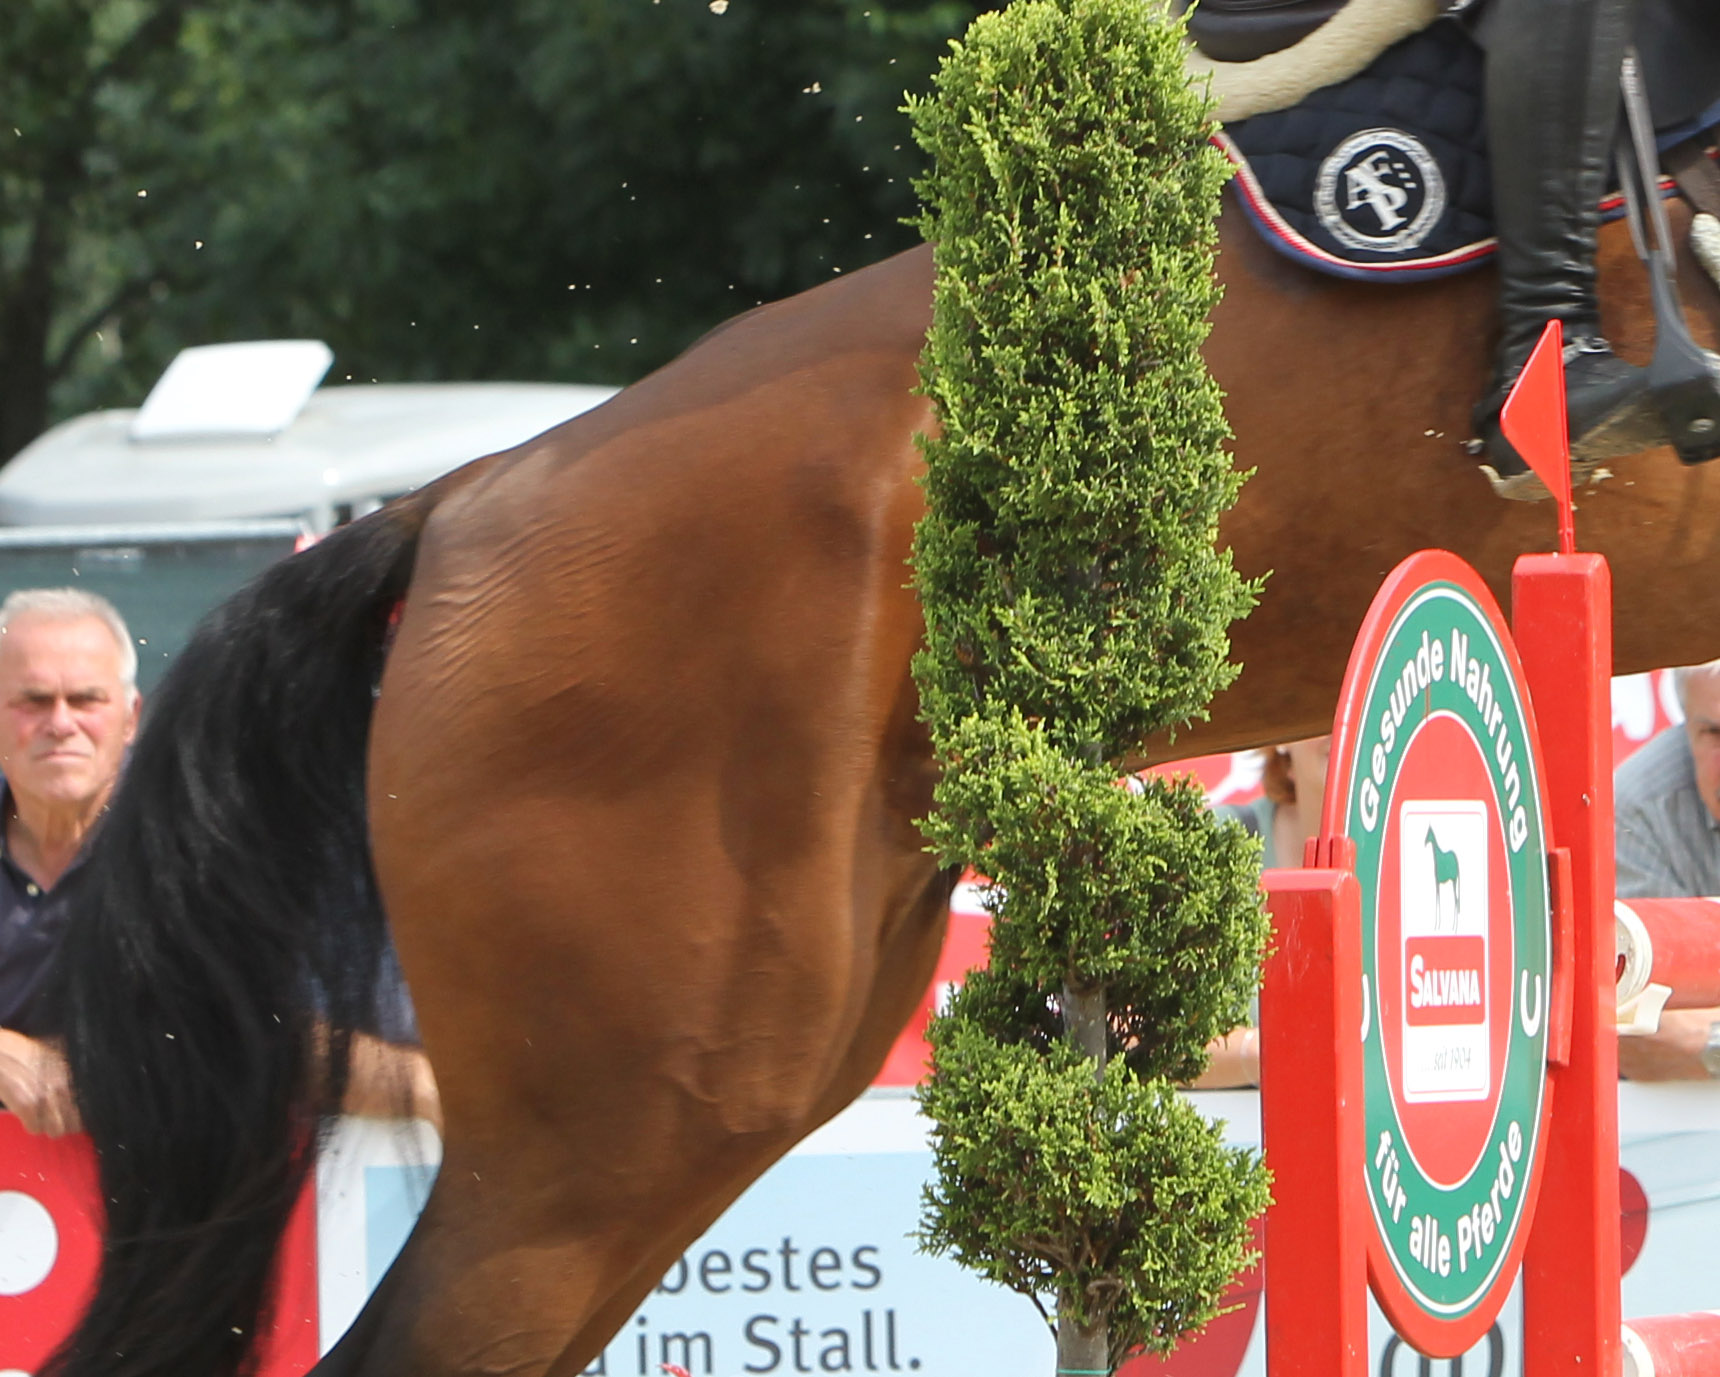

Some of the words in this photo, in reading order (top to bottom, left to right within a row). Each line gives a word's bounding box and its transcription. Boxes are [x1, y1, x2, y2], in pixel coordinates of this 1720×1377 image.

[1360, 629, 1444, 832] Gesunde
[1450, 627, 1528, 853] Nahrung
[1410, 954, 1481, 1009] SALVANA
[1375, 1130, 1407, 1224] für
[1409, 1214, 1451, 1277] alle
[1457, 1120, 1522, 1273] Pferde
[636, 1315, 713, 1375] im
[743, 1309, 922, 1375] Stall.
